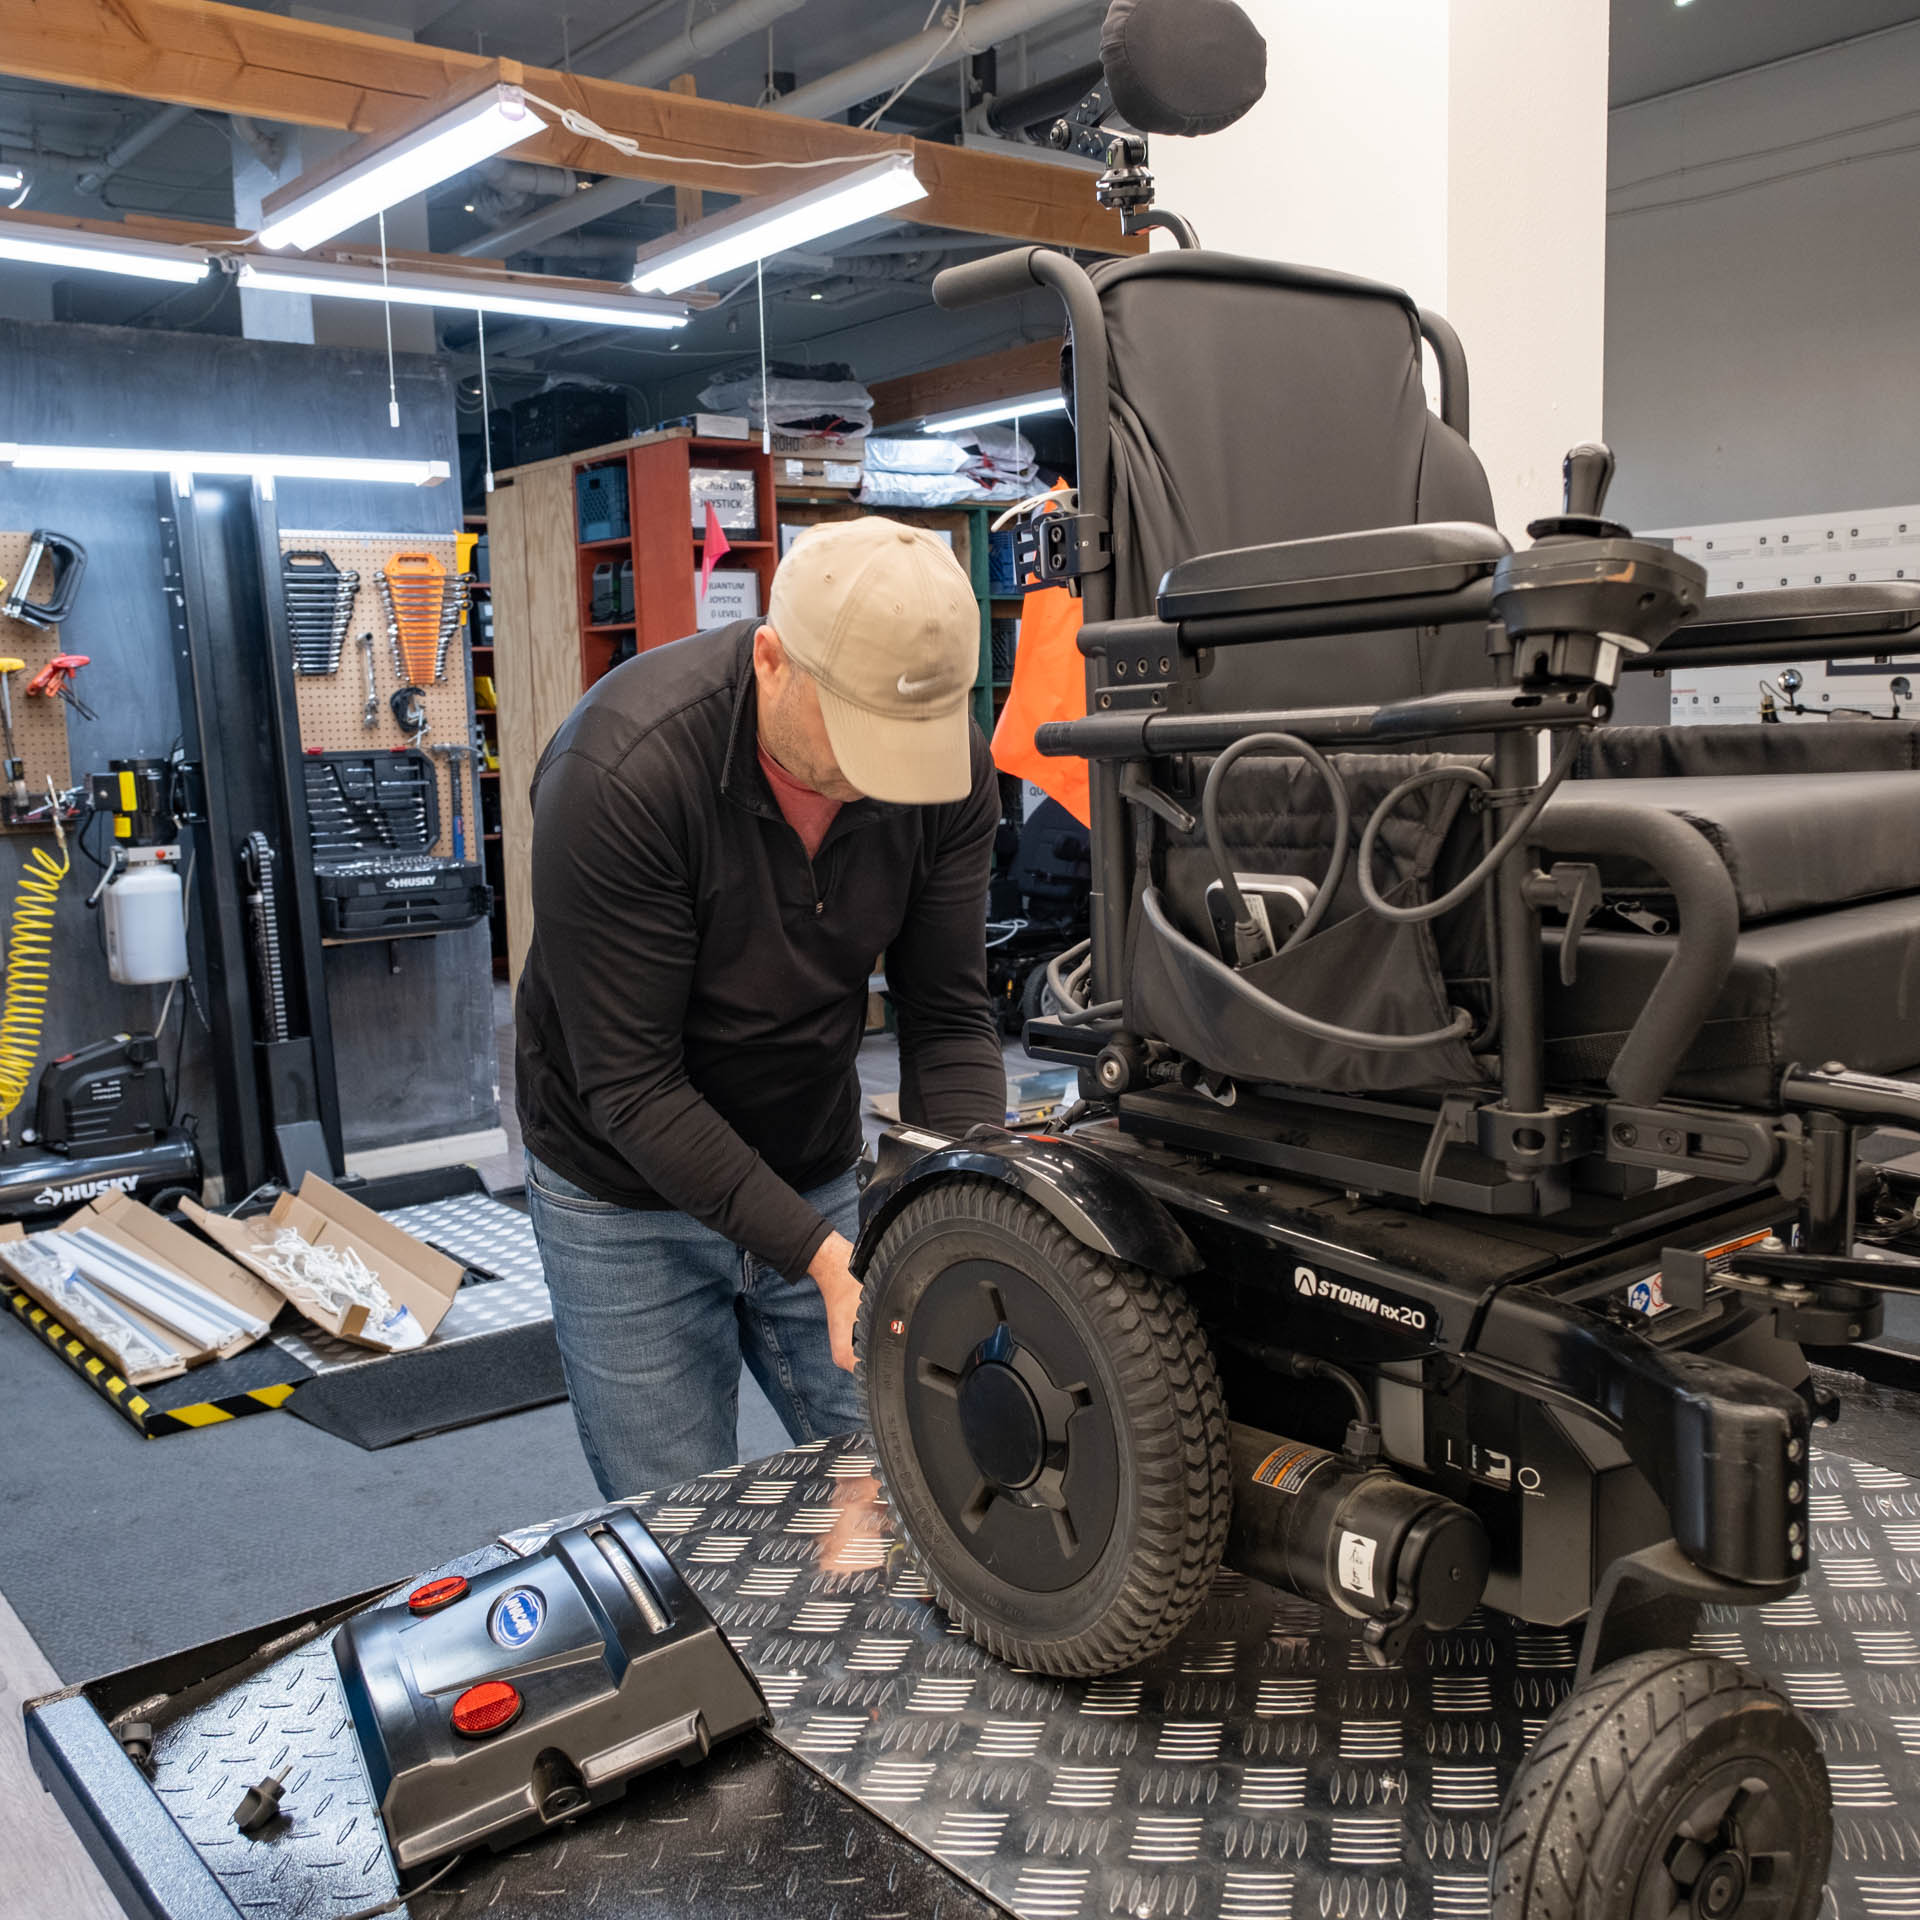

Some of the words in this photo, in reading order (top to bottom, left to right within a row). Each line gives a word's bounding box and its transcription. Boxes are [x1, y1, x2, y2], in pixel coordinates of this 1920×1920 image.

[699, 498, 743, 509] JYSTICK
[399, 876, 436, 888] HUSKY
[1317, 1280, 1380, 1314] STORM
[1380, 1304, 1426, 1330] RX20
